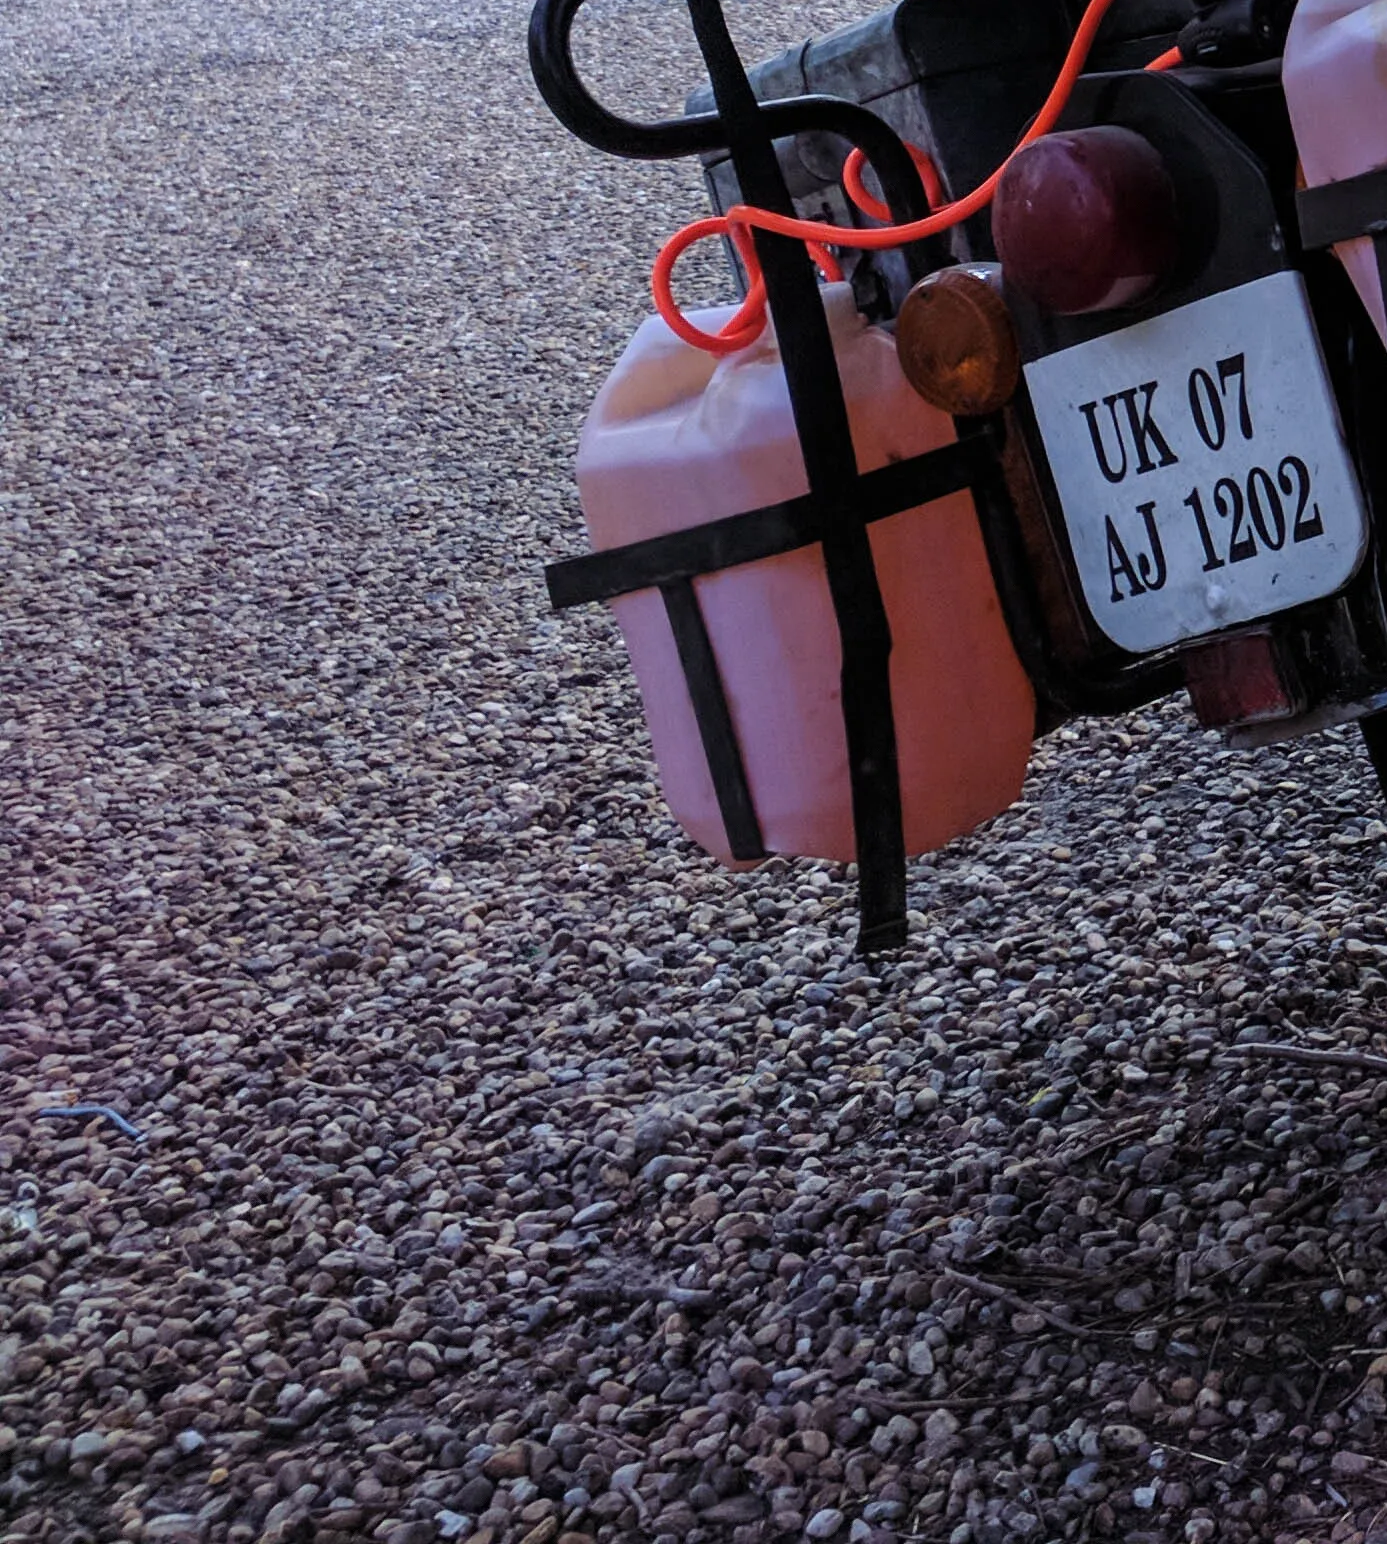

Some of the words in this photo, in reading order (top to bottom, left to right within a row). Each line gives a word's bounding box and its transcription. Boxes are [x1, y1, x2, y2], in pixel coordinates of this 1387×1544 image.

[1078, 380, 1179, 483] UK
[1187, 352, 1253, 452] 07
[1104, 501, 1168, 604] AJ
[1183, 455, 1325, 572] 1202
